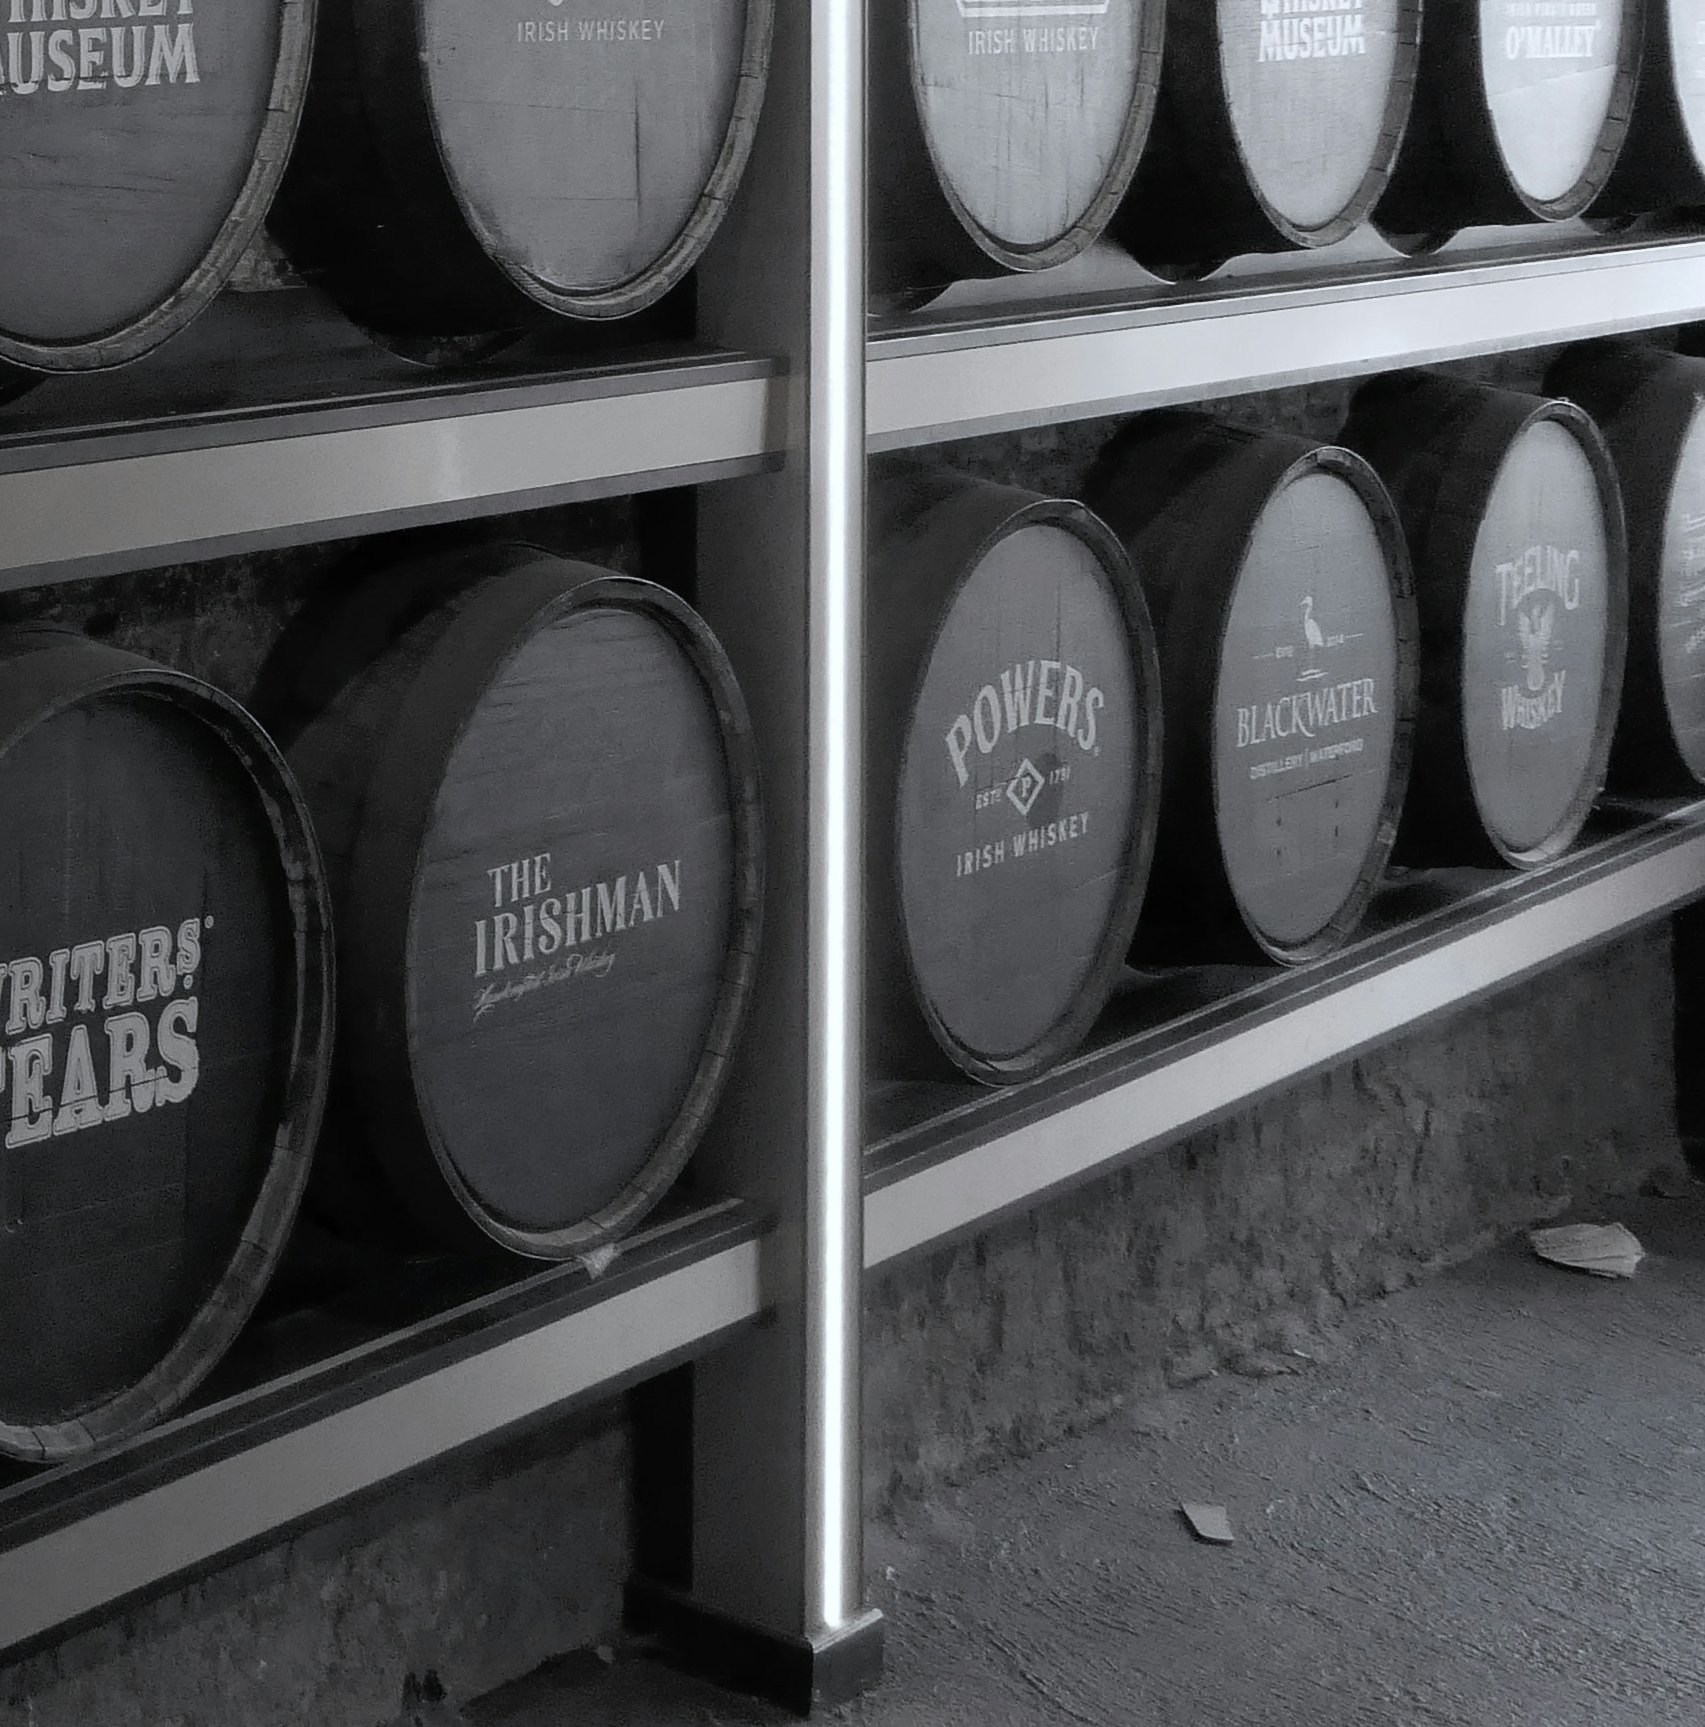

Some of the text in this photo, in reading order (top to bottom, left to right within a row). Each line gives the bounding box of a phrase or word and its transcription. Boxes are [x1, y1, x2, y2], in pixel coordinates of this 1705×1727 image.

[517, 19, 665, 42] IRISH WHISKEY
[968, 25, 1099, 55] IRISH WHISKEY
[1257, 14, 1366, 62] MUSEUM
[945, 660, 1104, 788] POWERS
[1237, 679, 1378, 748] BLACKWATER
[956, 812, 1089, 877] IRISH WHISKEY
[487, 853, 551, 907] THE
[475, 860, 681, 977] IRISHMAN
